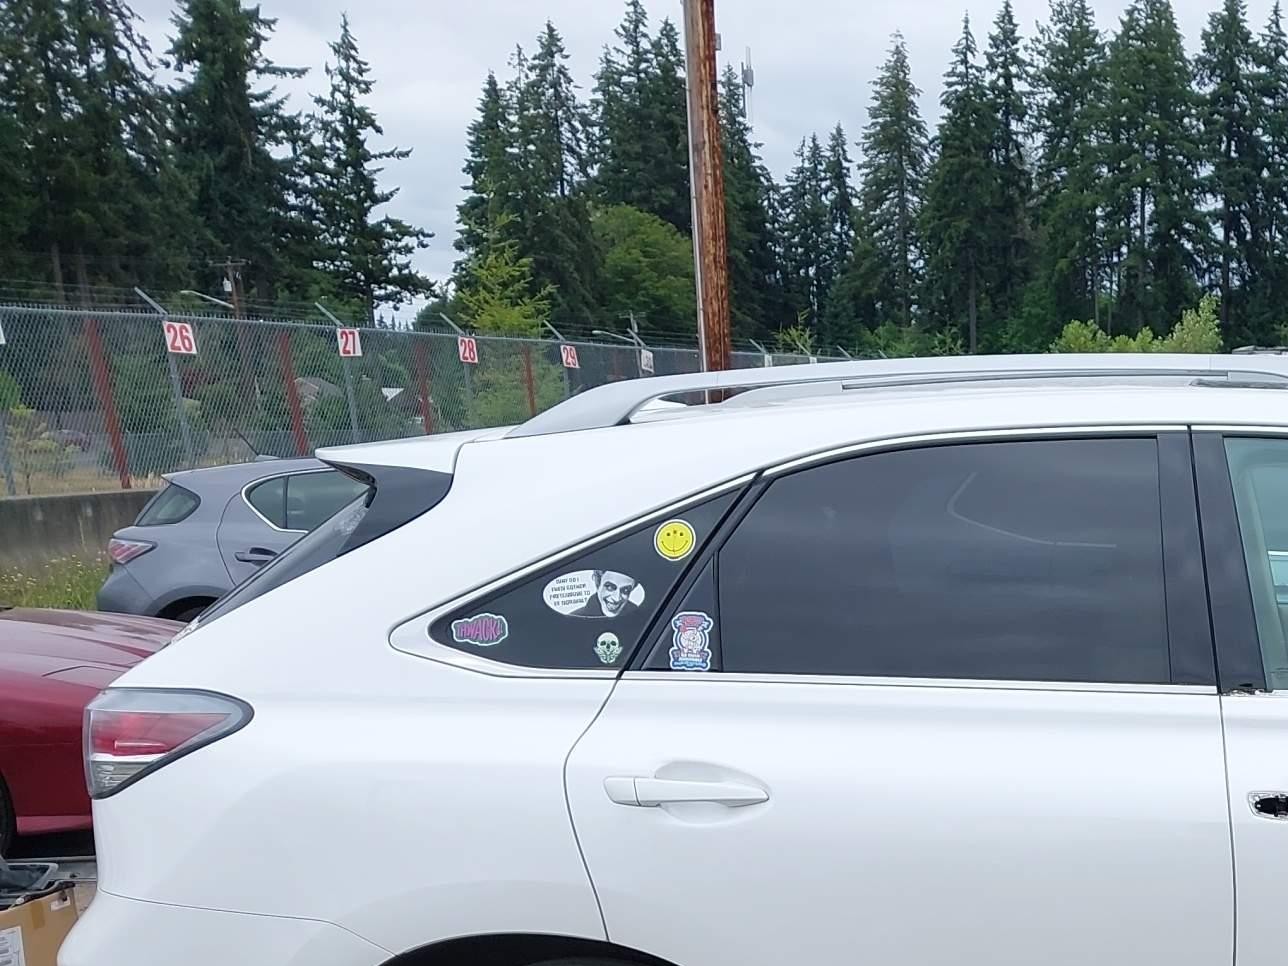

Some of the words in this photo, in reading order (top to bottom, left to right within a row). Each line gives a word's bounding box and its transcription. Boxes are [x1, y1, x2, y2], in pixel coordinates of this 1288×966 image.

[166, 323, 193, 352] 26
[340, 330, 356, 355] 27
[460, 338, 476, 361] 28
[563, 346, 577, 367] 29
